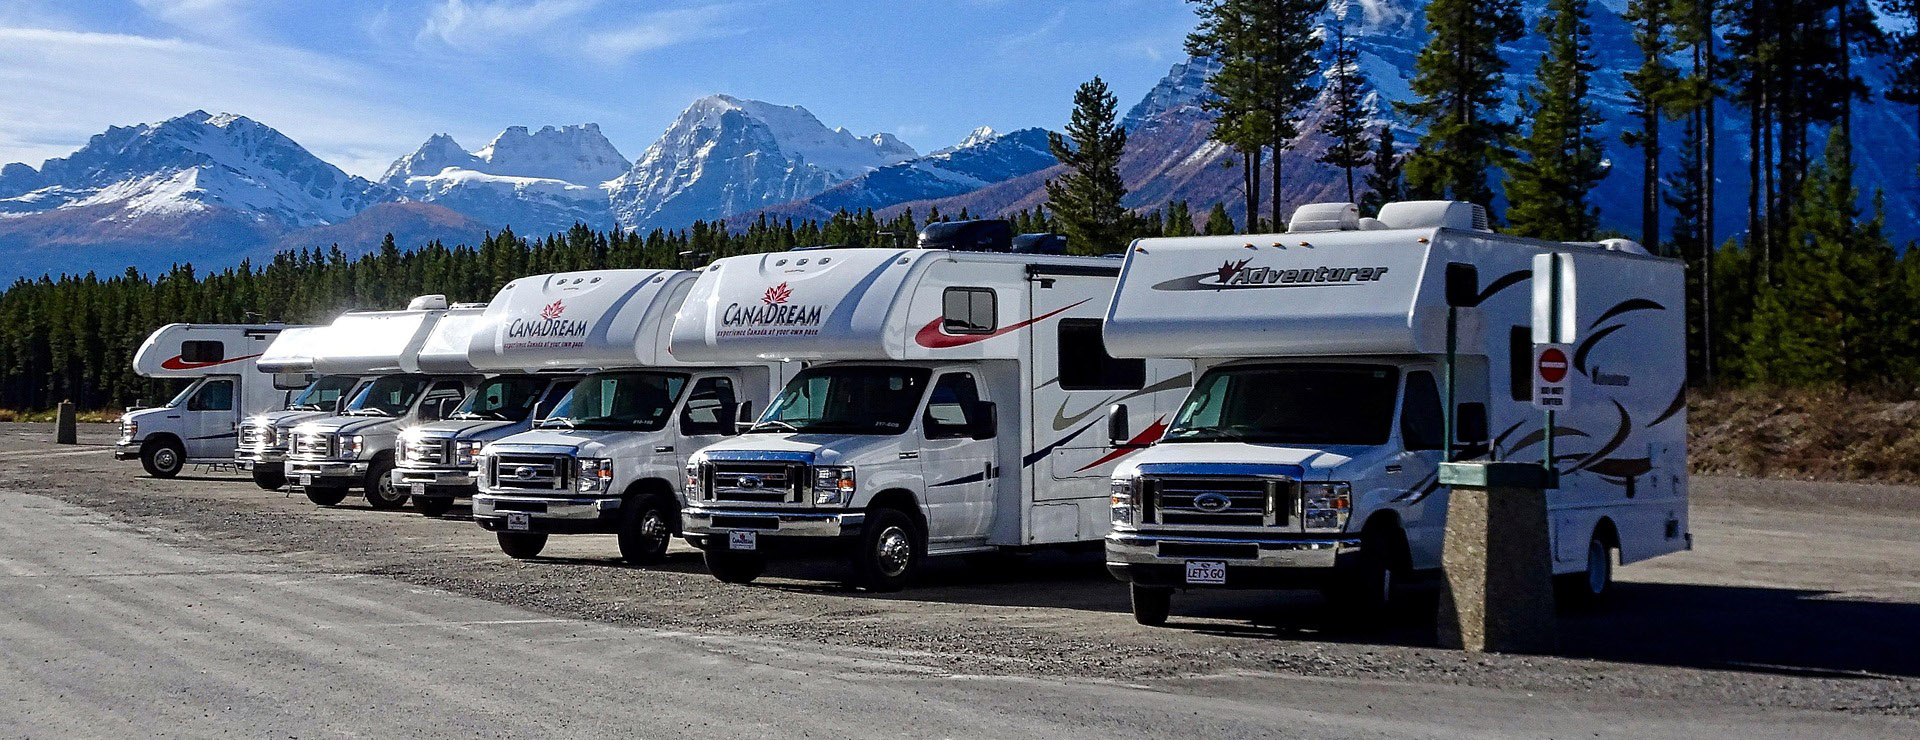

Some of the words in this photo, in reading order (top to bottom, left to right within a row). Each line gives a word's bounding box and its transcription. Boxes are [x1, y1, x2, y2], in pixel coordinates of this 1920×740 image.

[1231, 266, 1388, 284] Adventurer
[717, 329, 746, 338] experience
[747, 328, 767, 337] Canada
[768, 328, 775, 336] at
[776, 329, 790, 337] your
[804, 329, 818, 337] pace
[1542, 397, 1563, 406] ENTER
[1210, 568, 1224, 579] GO
